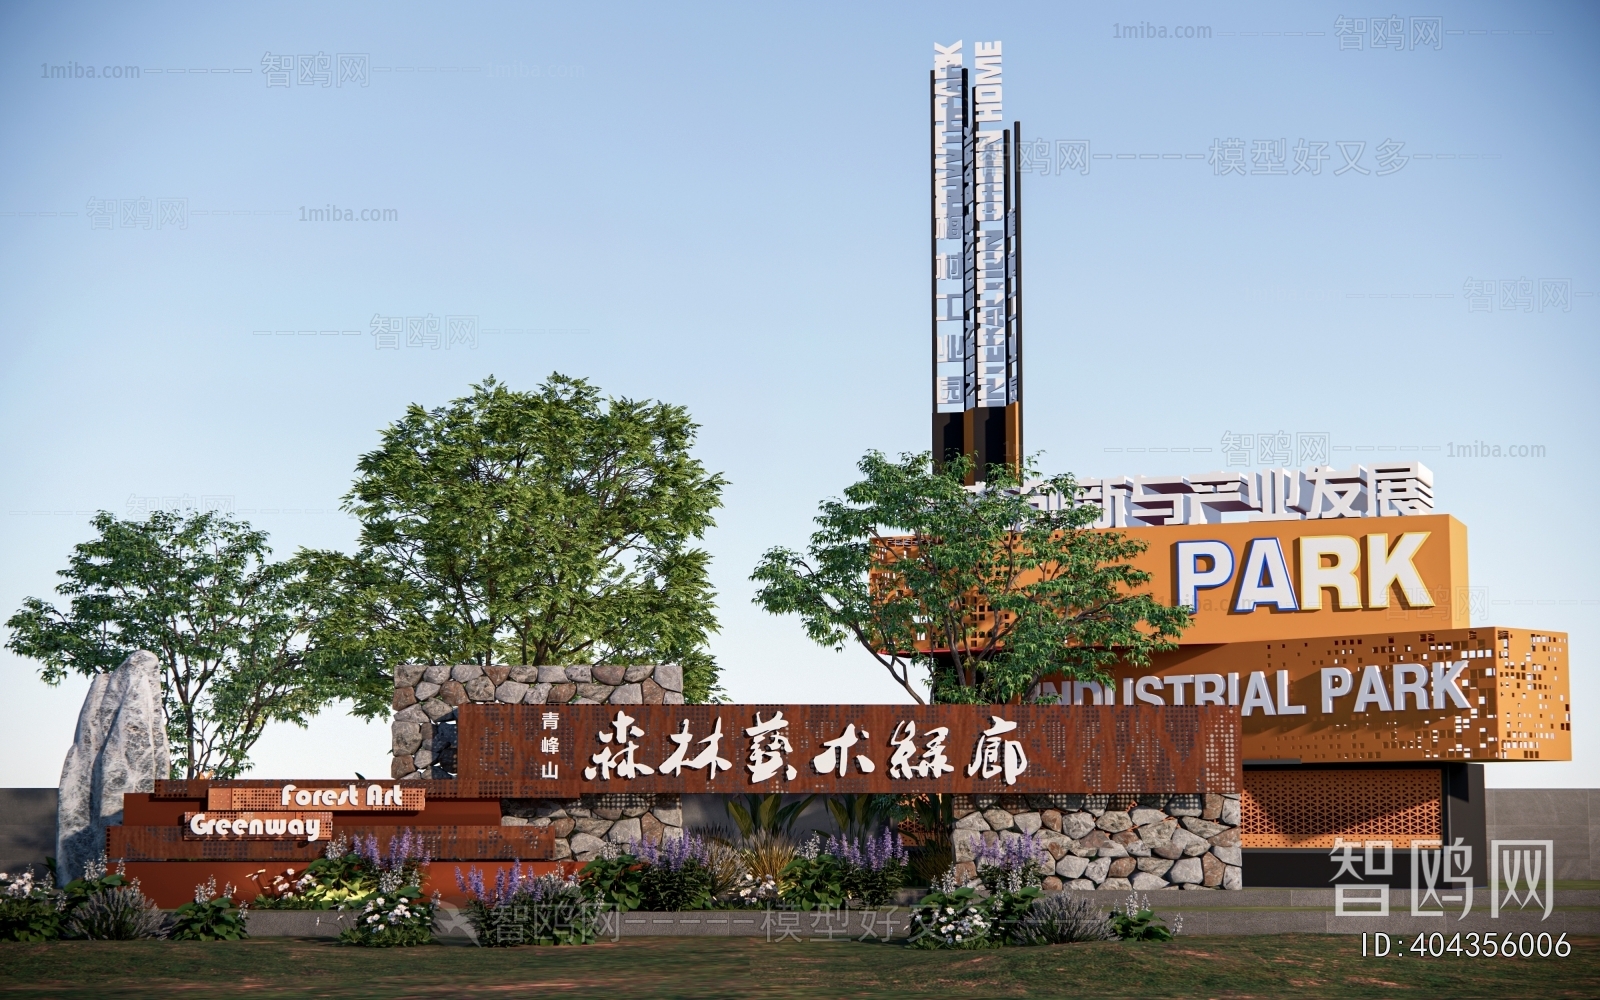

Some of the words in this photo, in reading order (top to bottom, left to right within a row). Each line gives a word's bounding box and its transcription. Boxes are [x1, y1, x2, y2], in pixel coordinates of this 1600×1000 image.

[975, 40, 1003, 122] HOME
[1174, 531, 1436, 615] PARK
[1321, 659, 1472, 715] PARK
[541, 711, 560, 780] 青峰山
[281, 784, 358, 807] Forest
[366, 785, 403, 806] Art
[190, 813, 321, 842] Greenway
